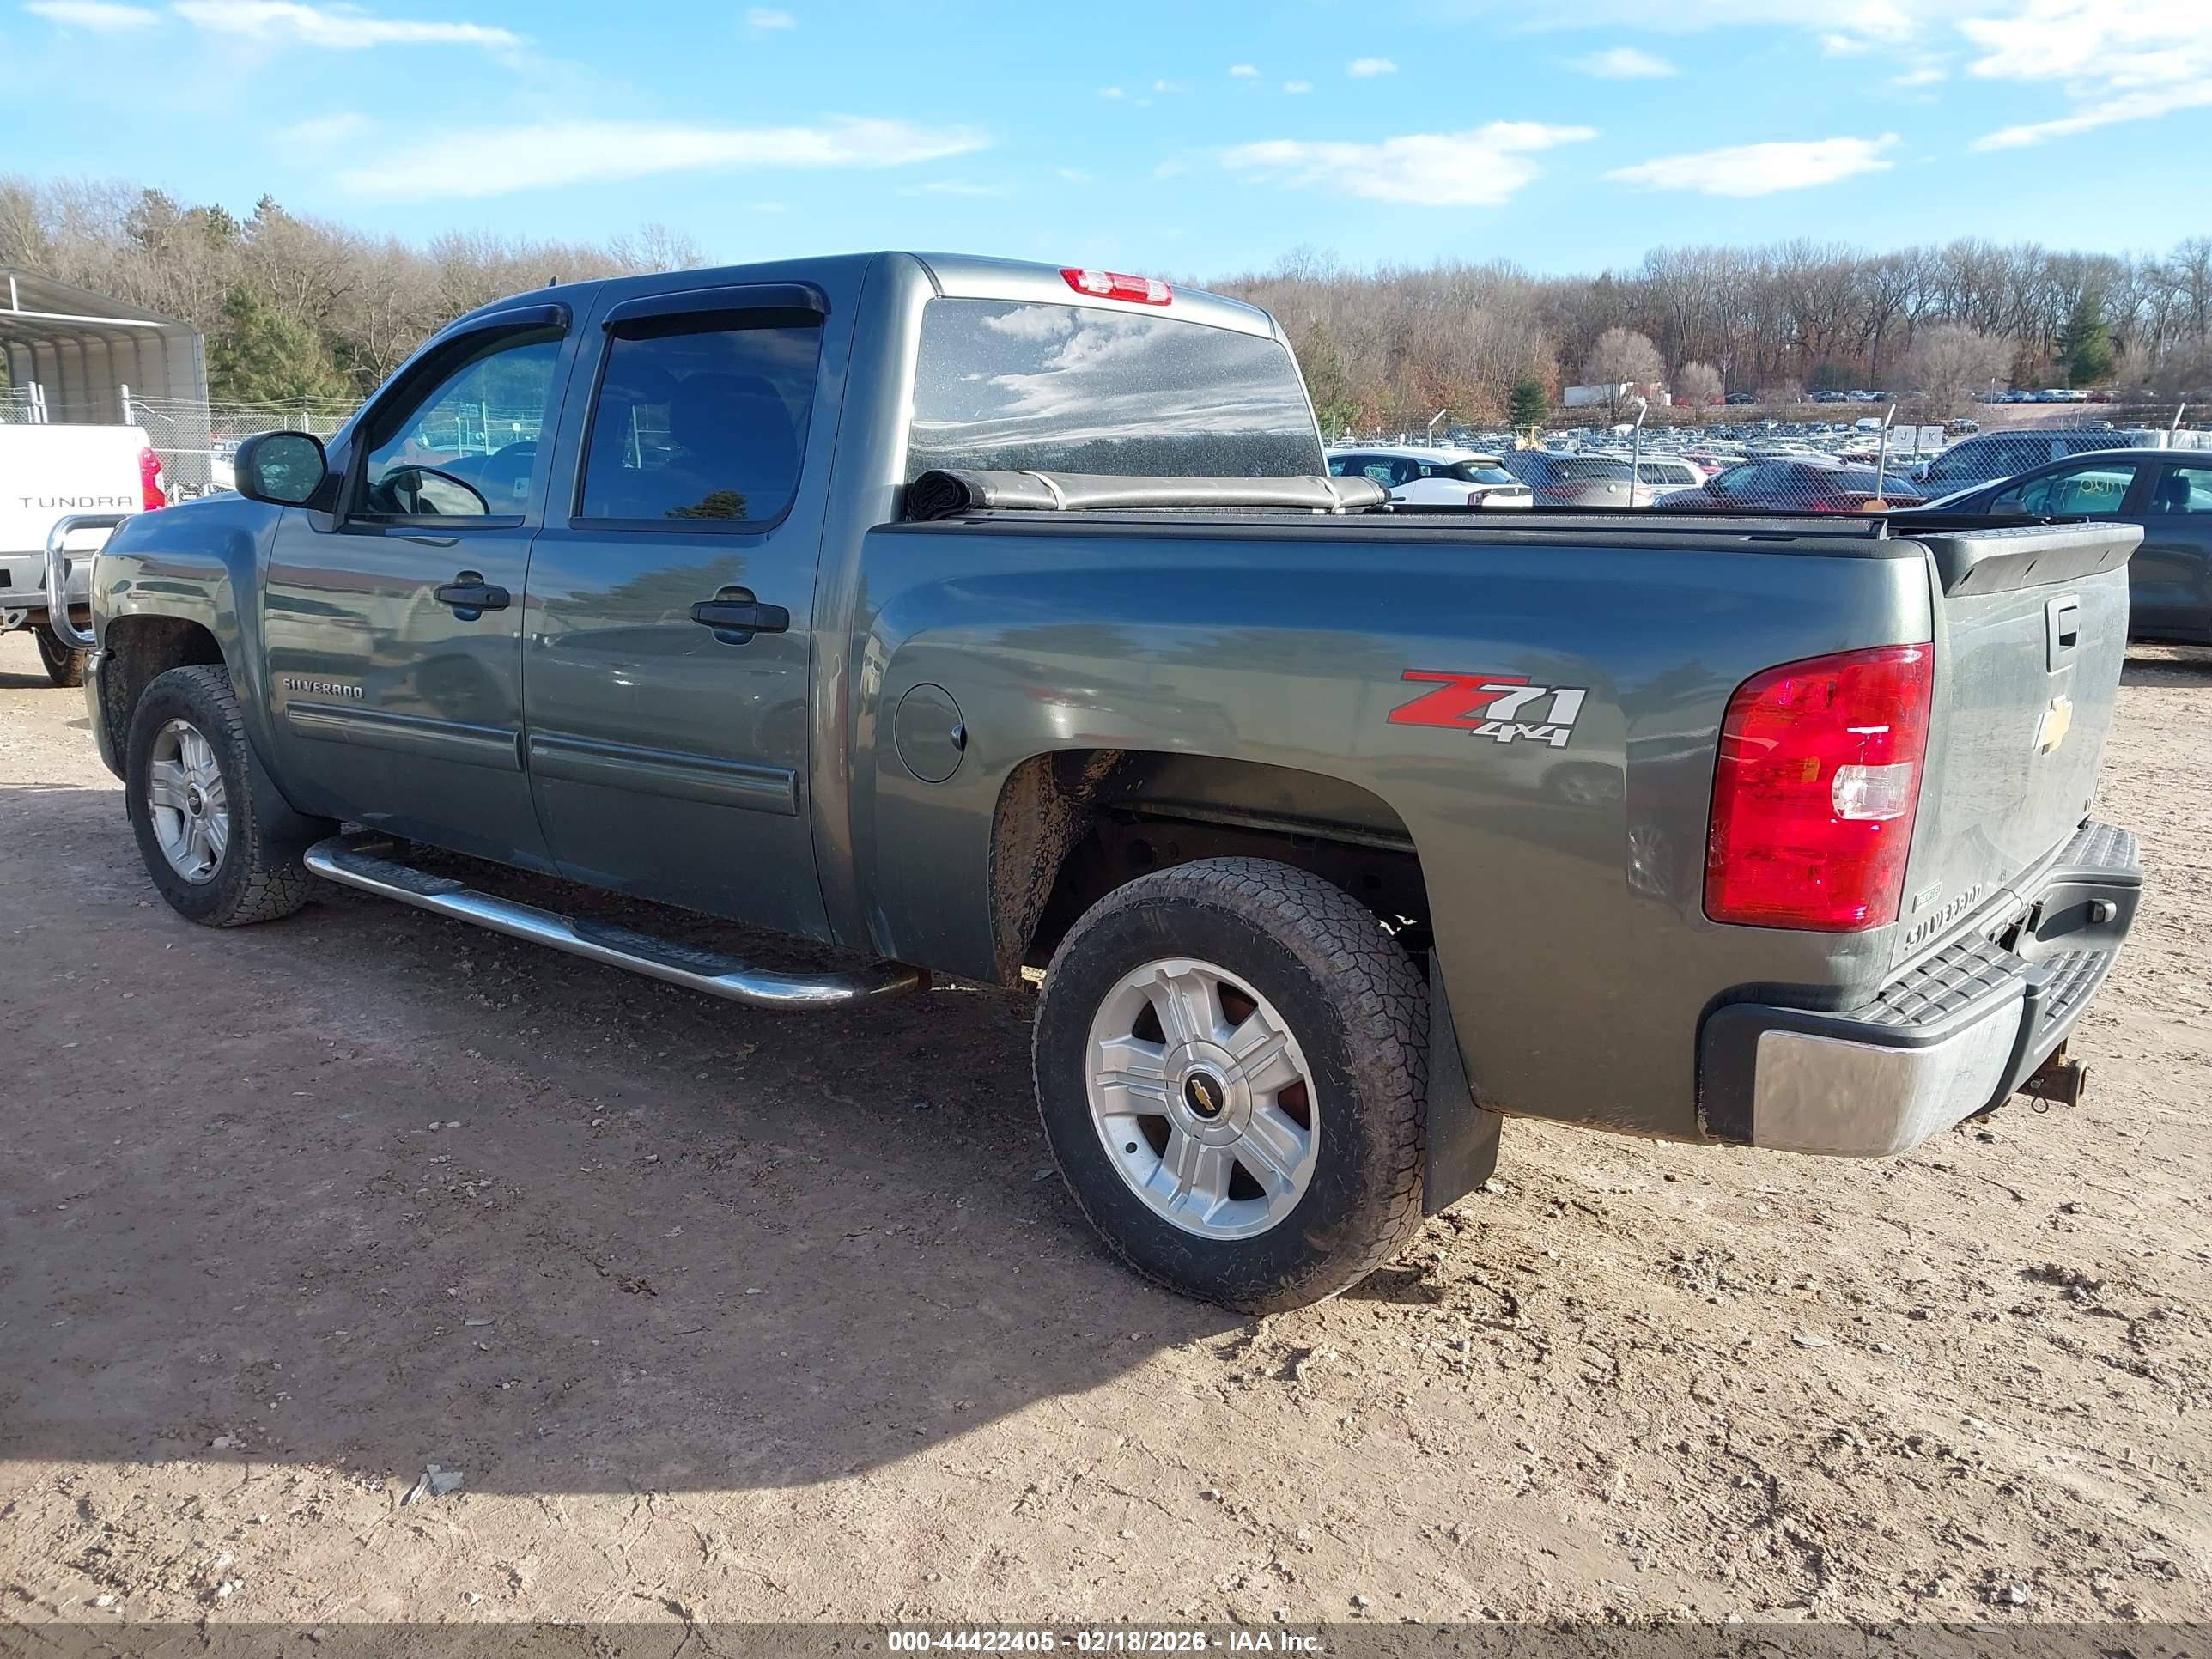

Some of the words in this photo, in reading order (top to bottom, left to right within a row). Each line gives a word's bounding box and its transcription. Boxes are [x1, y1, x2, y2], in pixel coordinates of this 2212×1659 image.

[1900, 432, 1908, 441] J
[1928, 432, 1936, 441] K
[18, 495, 134, 508] TUNDRA
[282, 678, 365, 699] SILVERADO
[1387, 669, 1589, 730] Z71
